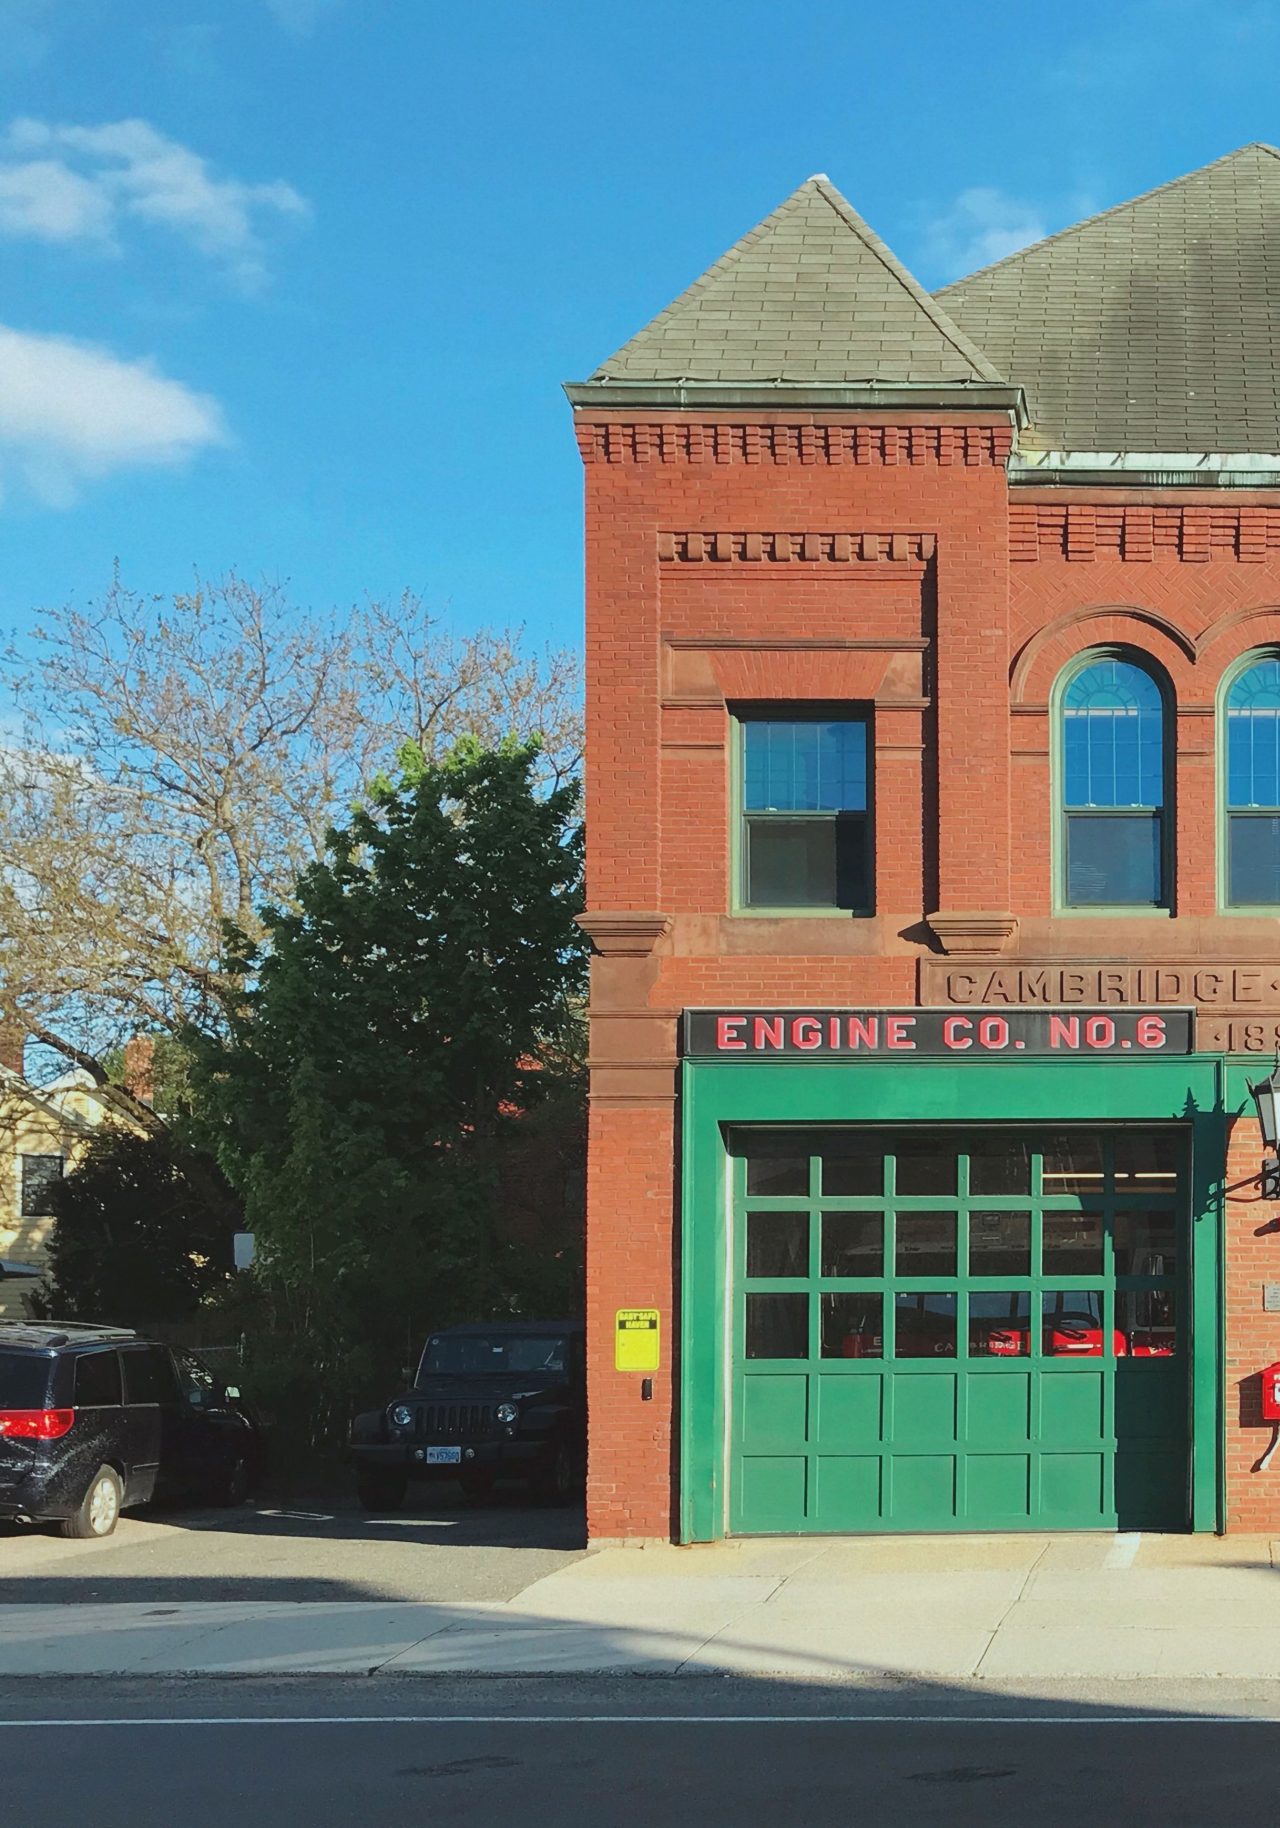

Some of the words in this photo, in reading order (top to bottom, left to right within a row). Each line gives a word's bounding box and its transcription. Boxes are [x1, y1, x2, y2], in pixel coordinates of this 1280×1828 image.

[946, 968, 1262, 1004] CAMBRIDGE
[716, 1015, 917, 1050] ENGINE
[943, 1015, 1026, 1050] CO.
